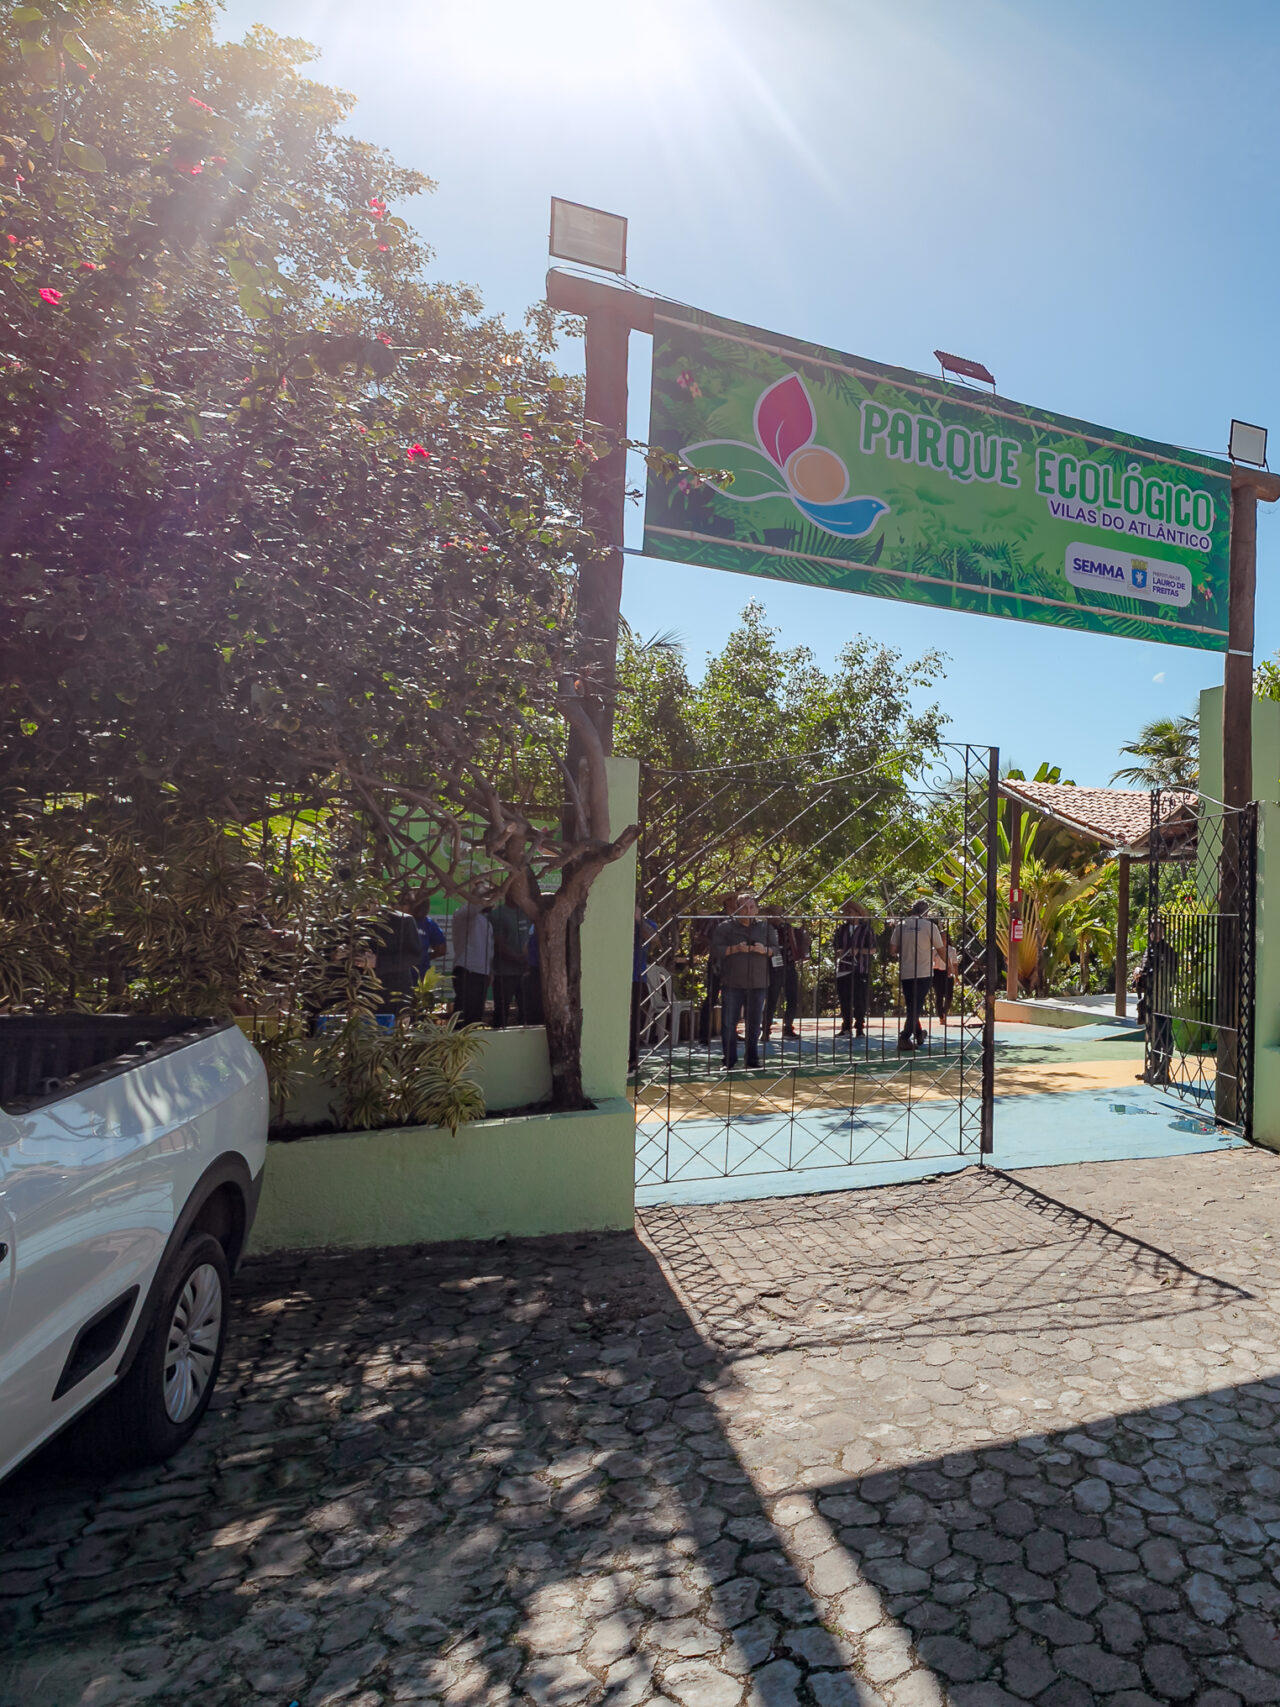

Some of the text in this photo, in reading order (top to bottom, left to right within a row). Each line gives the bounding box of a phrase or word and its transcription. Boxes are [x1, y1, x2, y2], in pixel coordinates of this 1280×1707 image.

[862, 402, 1212, 533] PARQUE ECOLÓGICO
[1050, 500, 1210, 550] VILAS DO ATLÂNTICO
[1072, 557, 1125, 580] SEMMA
[1152, 577, 1176, 588] LAURO
[1152, 586, 1179, 597] FREITAS
